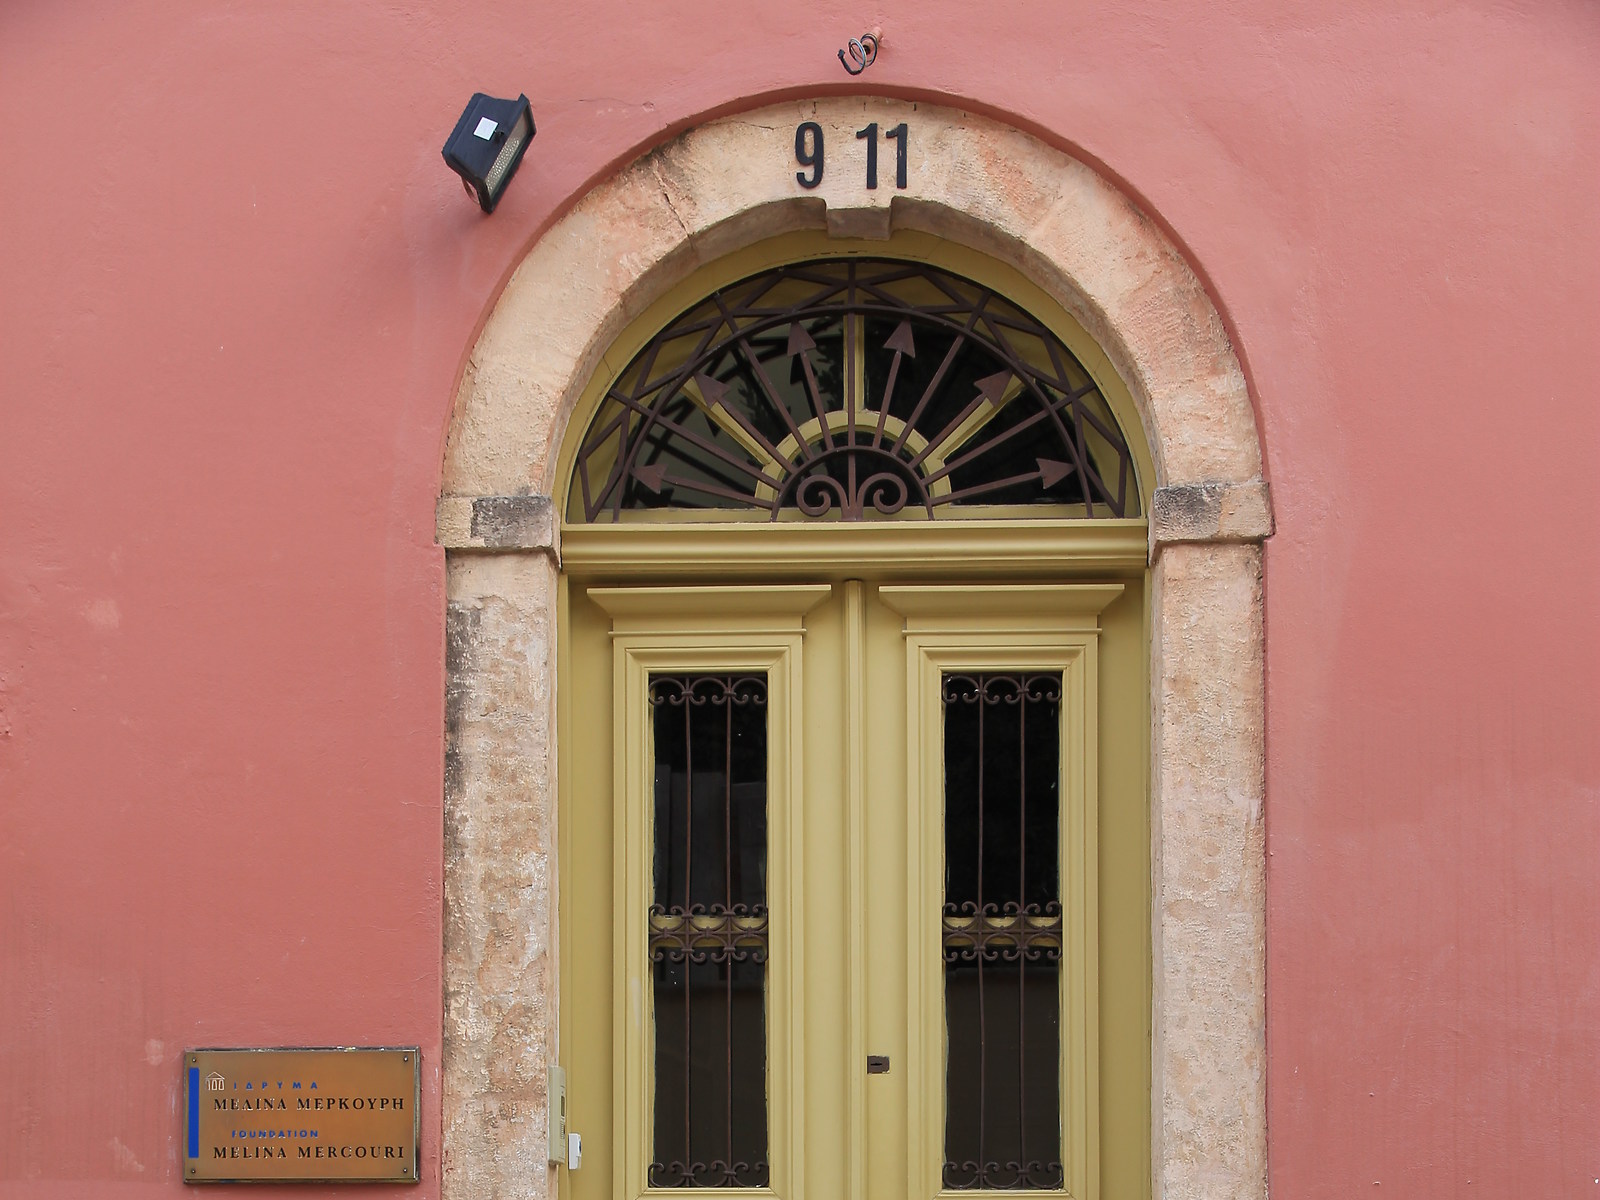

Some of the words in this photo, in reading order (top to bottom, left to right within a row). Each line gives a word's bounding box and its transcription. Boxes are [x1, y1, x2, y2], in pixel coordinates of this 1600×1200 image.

[234, 1081, 318, 1090] ΙΔΡΥΜΑ
[214, 1098, 287, 1110] ΜΕΛΙΝΑ
[297, 1098, 404, 1110] ΜΕΡΚΟΥΡΗ
[232, 1130, 318, 1138] FOUNDATION
[213, 1147, 287, 1159] MELINA
[298, 1146, 404, 1158] MERCOURI
